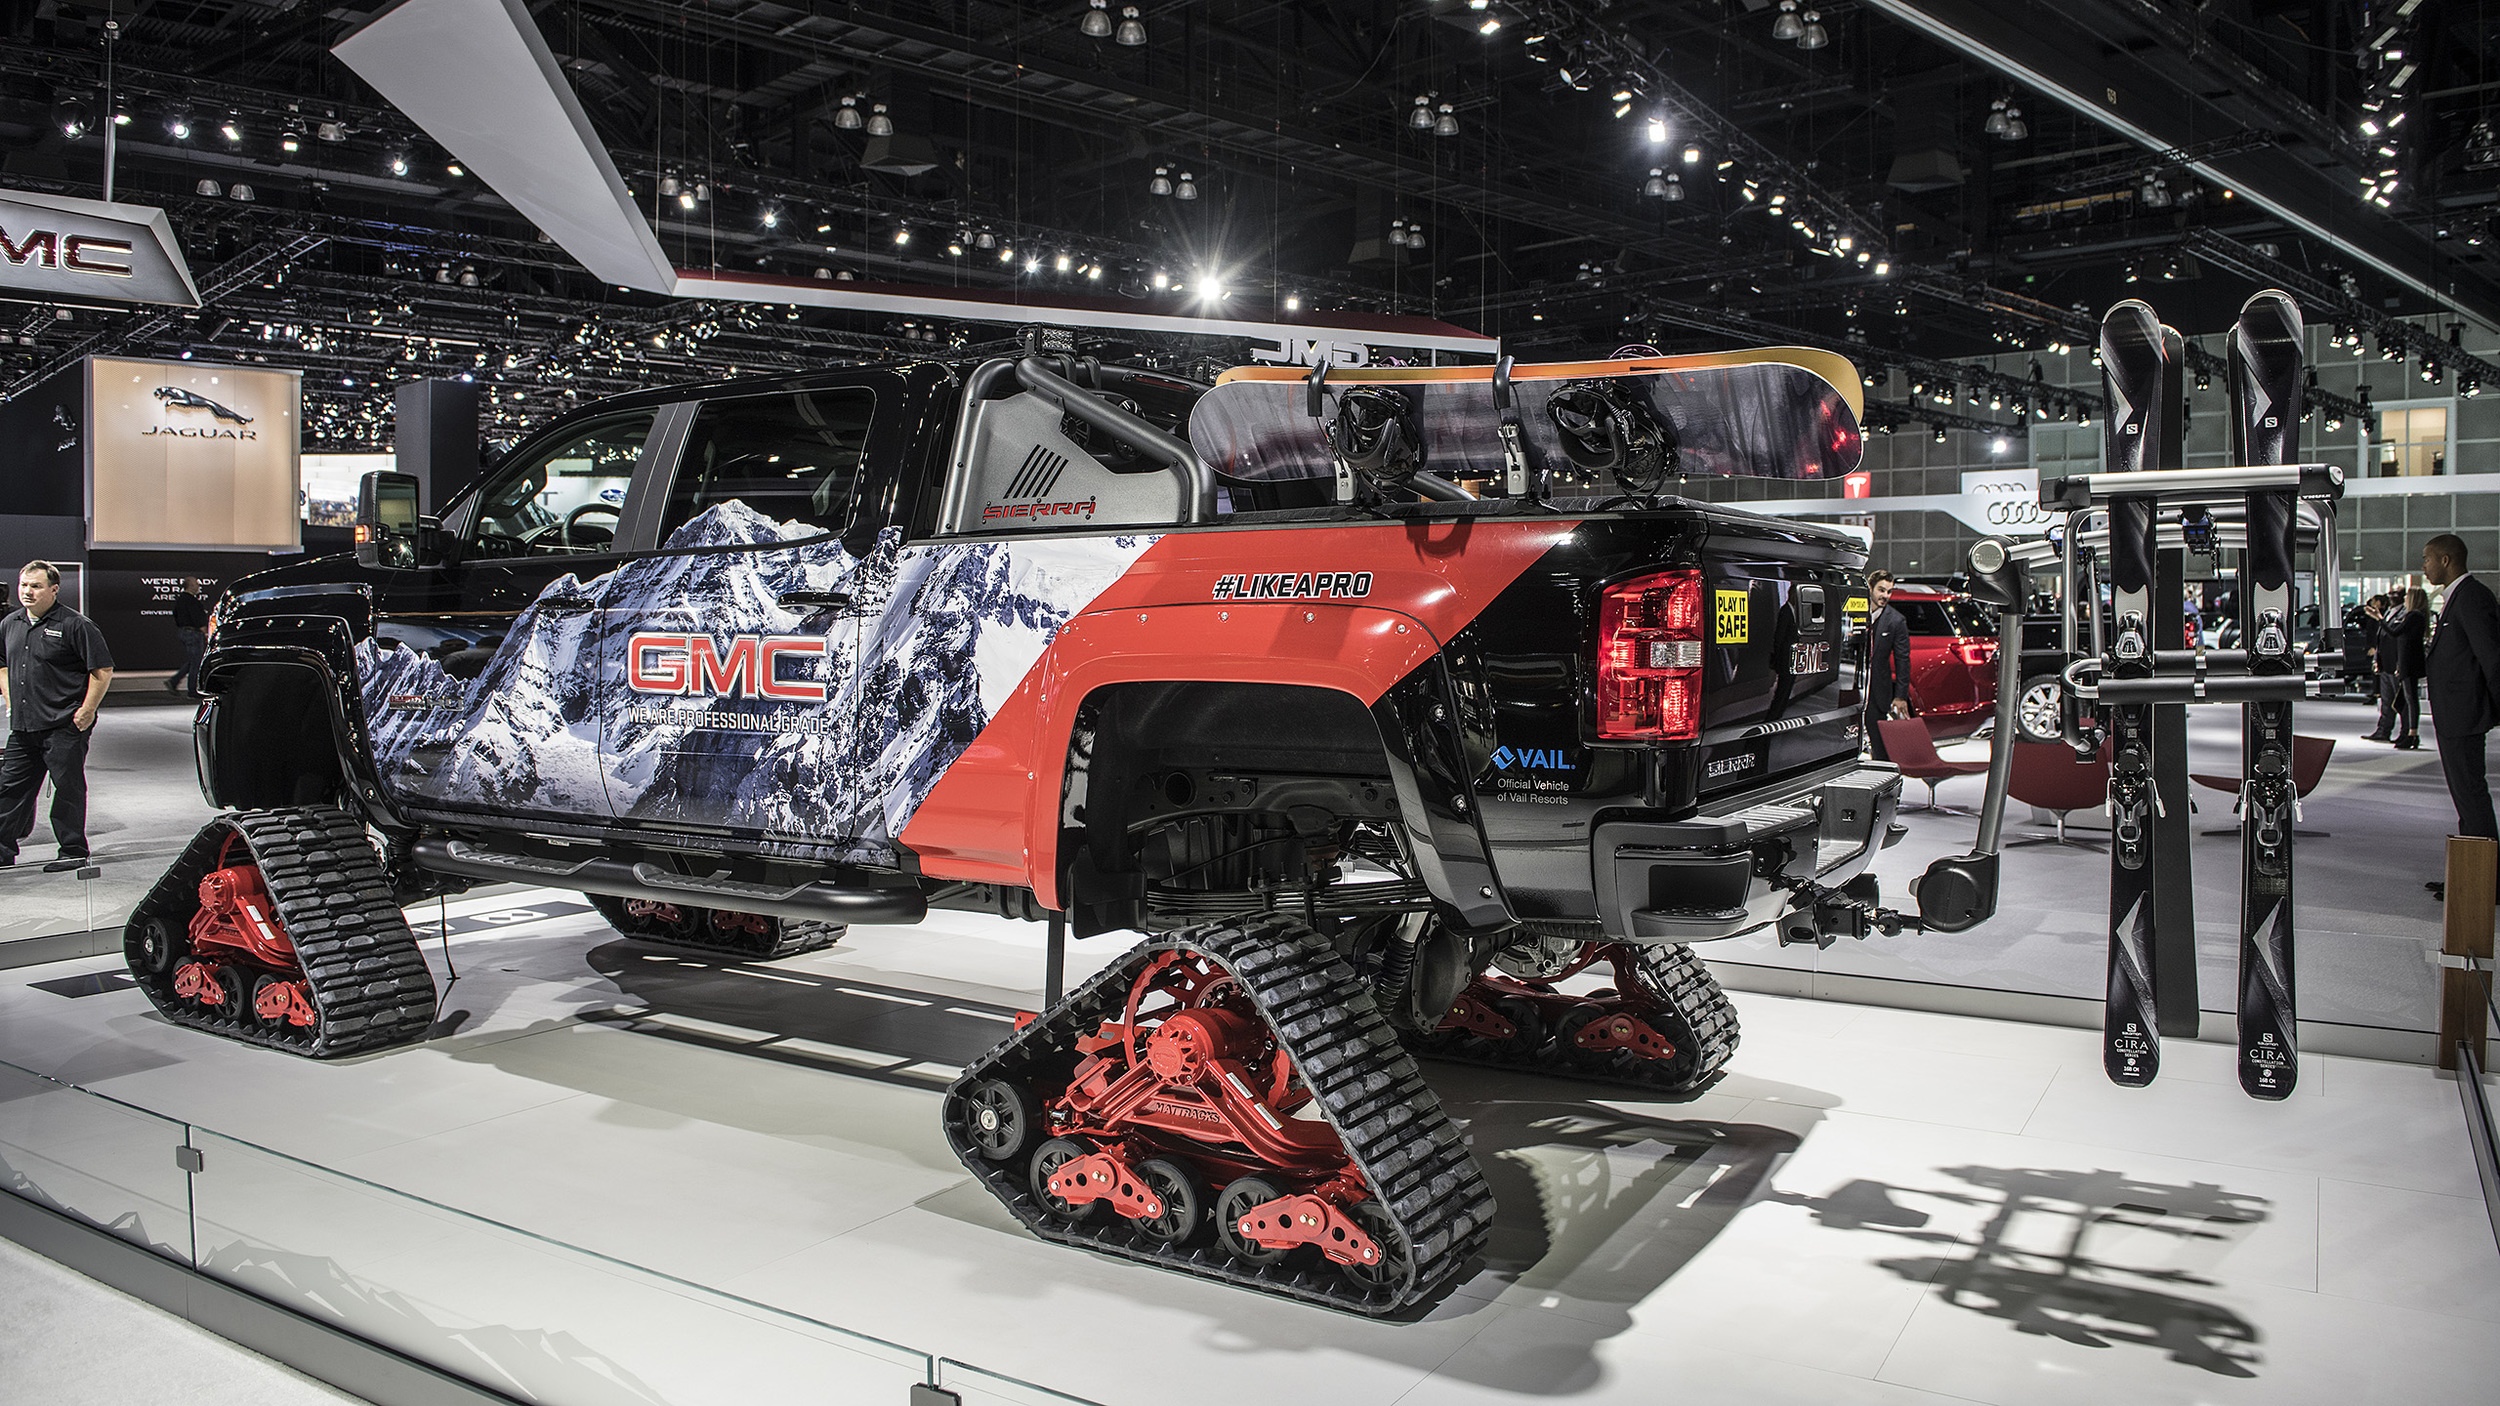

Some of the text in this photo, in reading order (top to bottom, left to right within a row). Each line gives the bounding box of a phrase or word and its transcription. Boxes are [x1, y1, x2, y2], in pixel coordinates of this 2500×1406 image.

[142, 425, 257, 440] JAGUAR
[983, 501, 1097, 520] SIERRA
[1211, 571, 1374, 600] #LIKEAPRO
[1718, 596, 1746, 613] PLAY IT
[1718, 614, 1747, 638] SAFE
[628, 631, 829, 703] GMC
[1790, 641, 1831, 675] GMC
[628, 706, 830, 735] WE ARE PROFESSIONAL GRADE
[1497, 778, 1570, 791] Official Vehicle
[1497, 792, 1569, 805] of Vail Resorts
[2114, 1038, 2149, 1050] CIRA
[2249, 1048, 2286, 1061] CIRA
[1156, 1102, 1221, 1124] MATTRACKS
